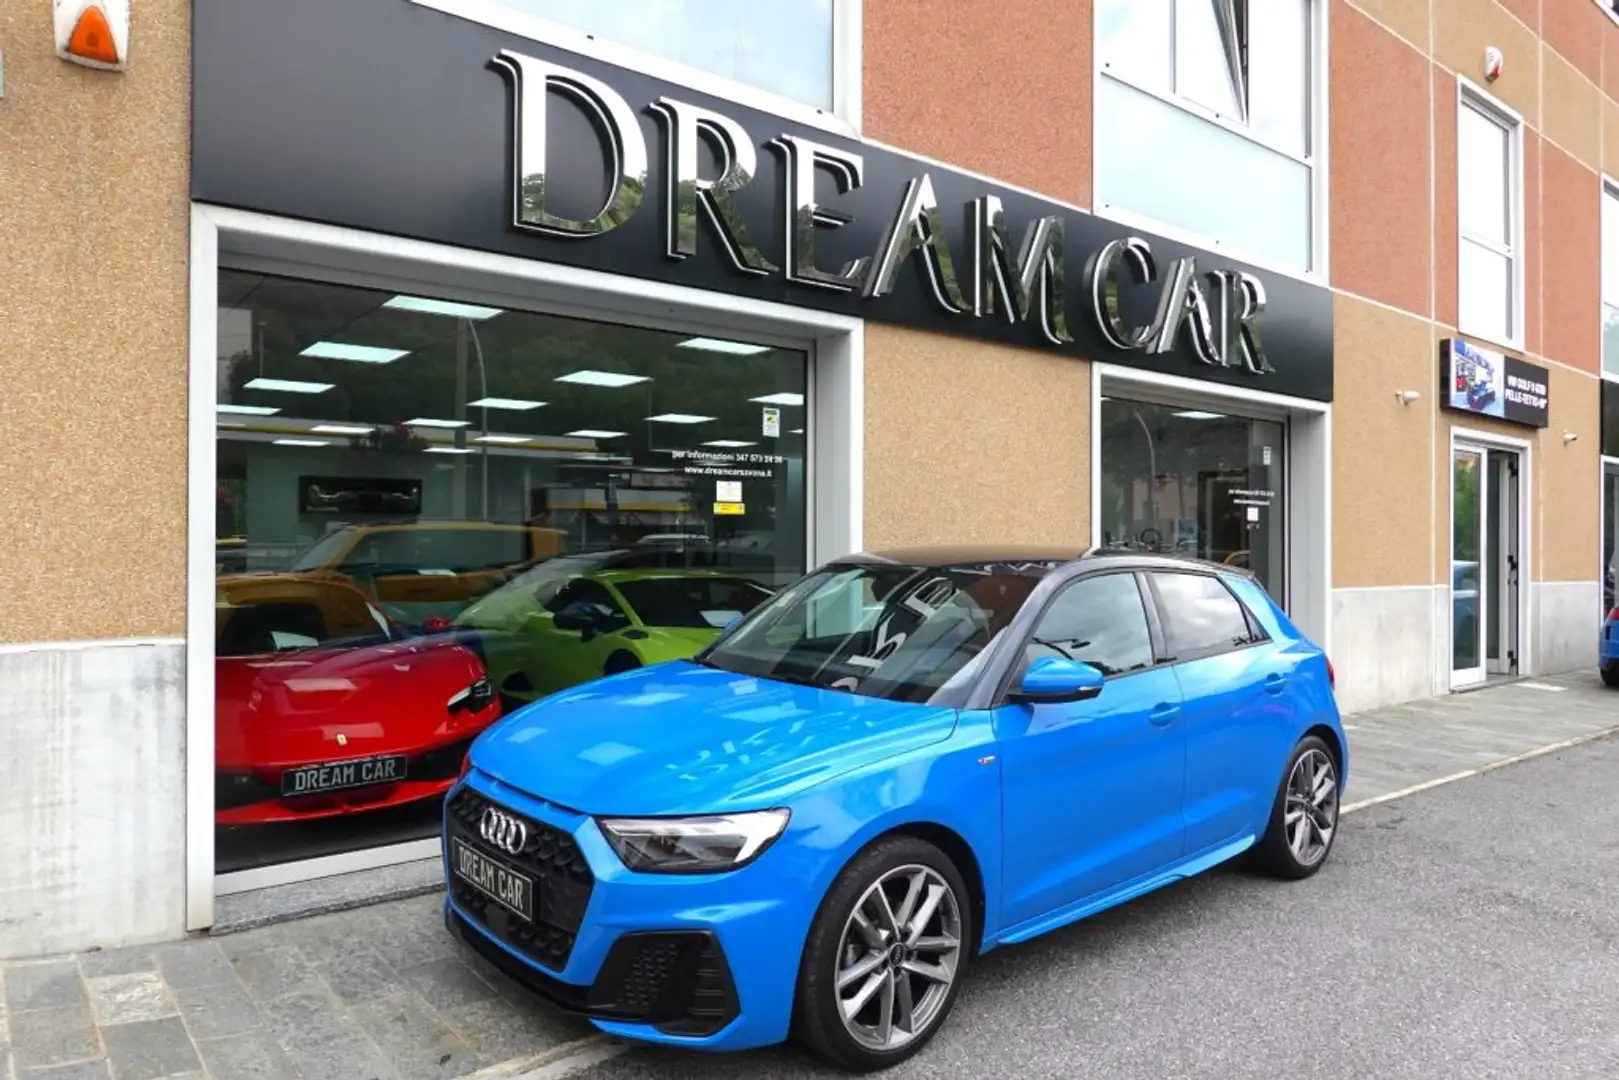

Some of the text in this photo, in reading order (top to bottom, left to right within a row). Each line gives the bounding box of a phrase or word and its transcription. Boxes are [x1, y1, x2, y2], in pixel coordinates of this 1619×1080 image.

[486, 48, 1276, 375] DREAM CAR
[672, 451, 686, 460] per
[687, 451, 734, 461] informazioni
[294, 759, 396, 791] DREAM CAR
[459, 846, 525, 910] DREAM CAR
